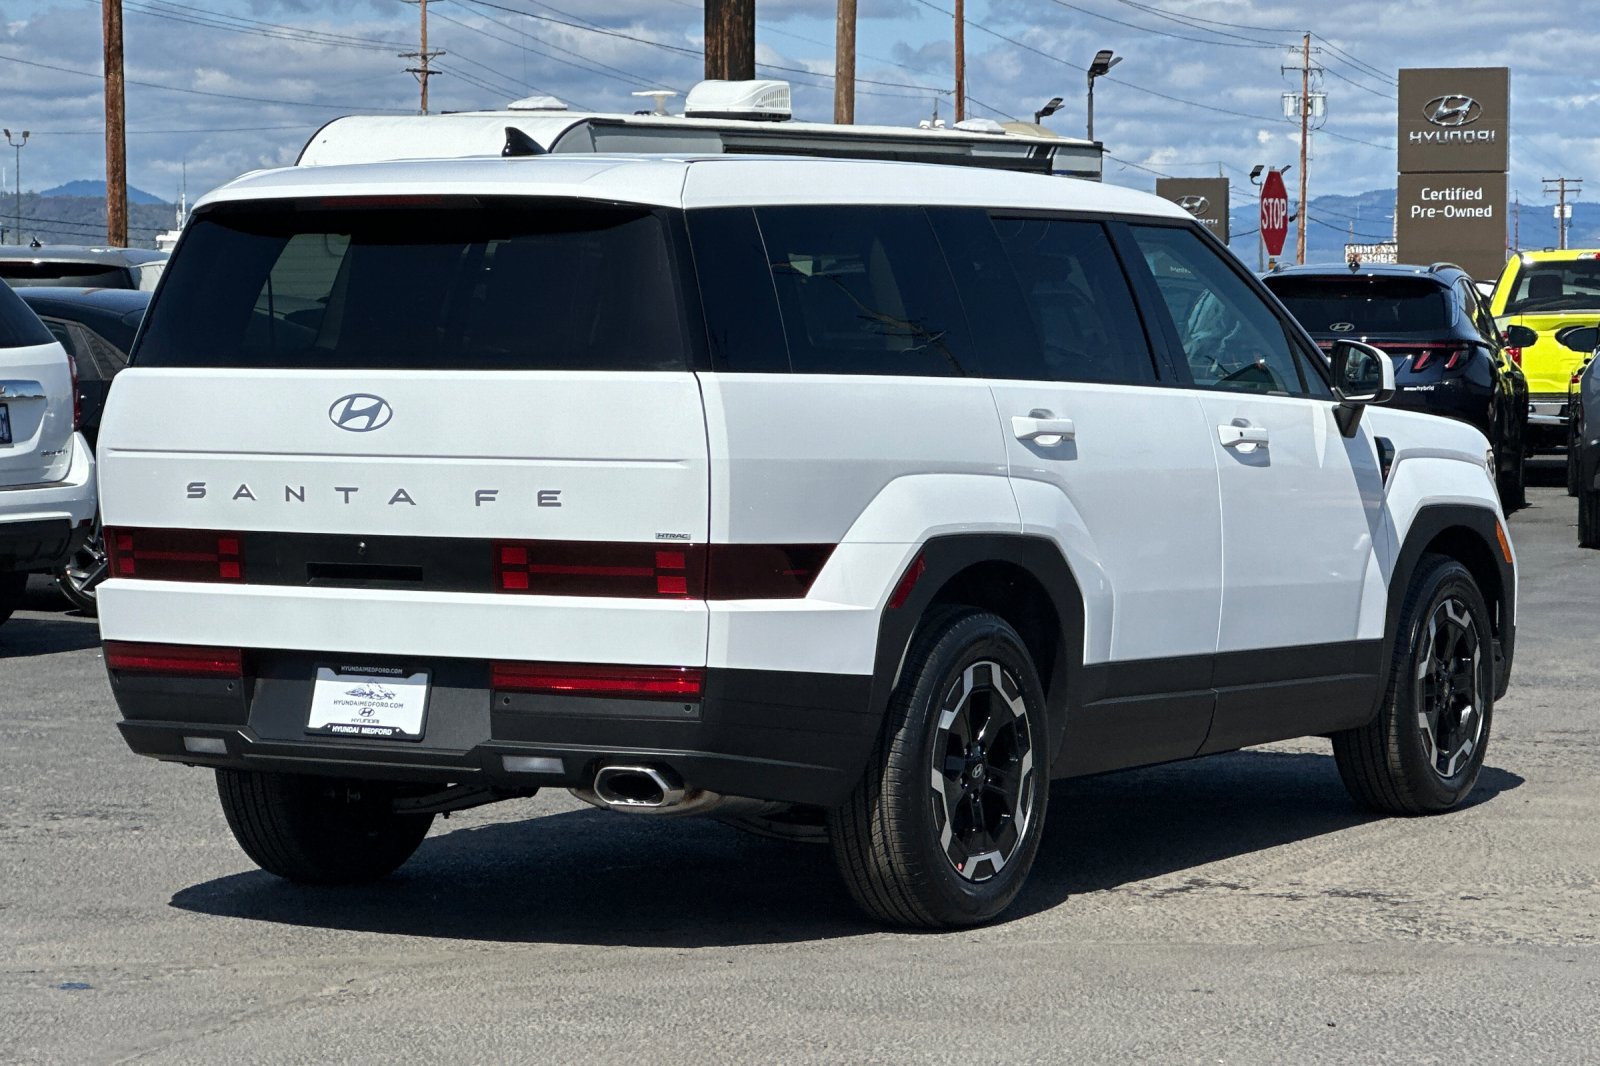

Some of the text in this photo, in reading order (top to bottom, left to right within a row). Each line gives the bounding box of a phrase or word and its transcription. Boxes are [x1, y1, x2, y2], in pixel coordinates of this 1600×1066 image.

[1409, 130, 1495, 144] HYUNDAI
[1421, 187, 1482, 200] Certified
[1262, 198, 1287, 229] STOP
[1411, 205, 1492, 218] Pre-Owned
[186, 482, 562, 507] SANTA FE
[341, 666, 403, 674] HYUNDAIMEDFORD.COM
[333, 700, 404, 709] HYUNDAIMEDFORD.COM
[332, 726, 392, 736] HYUNDAI MEDFORD
